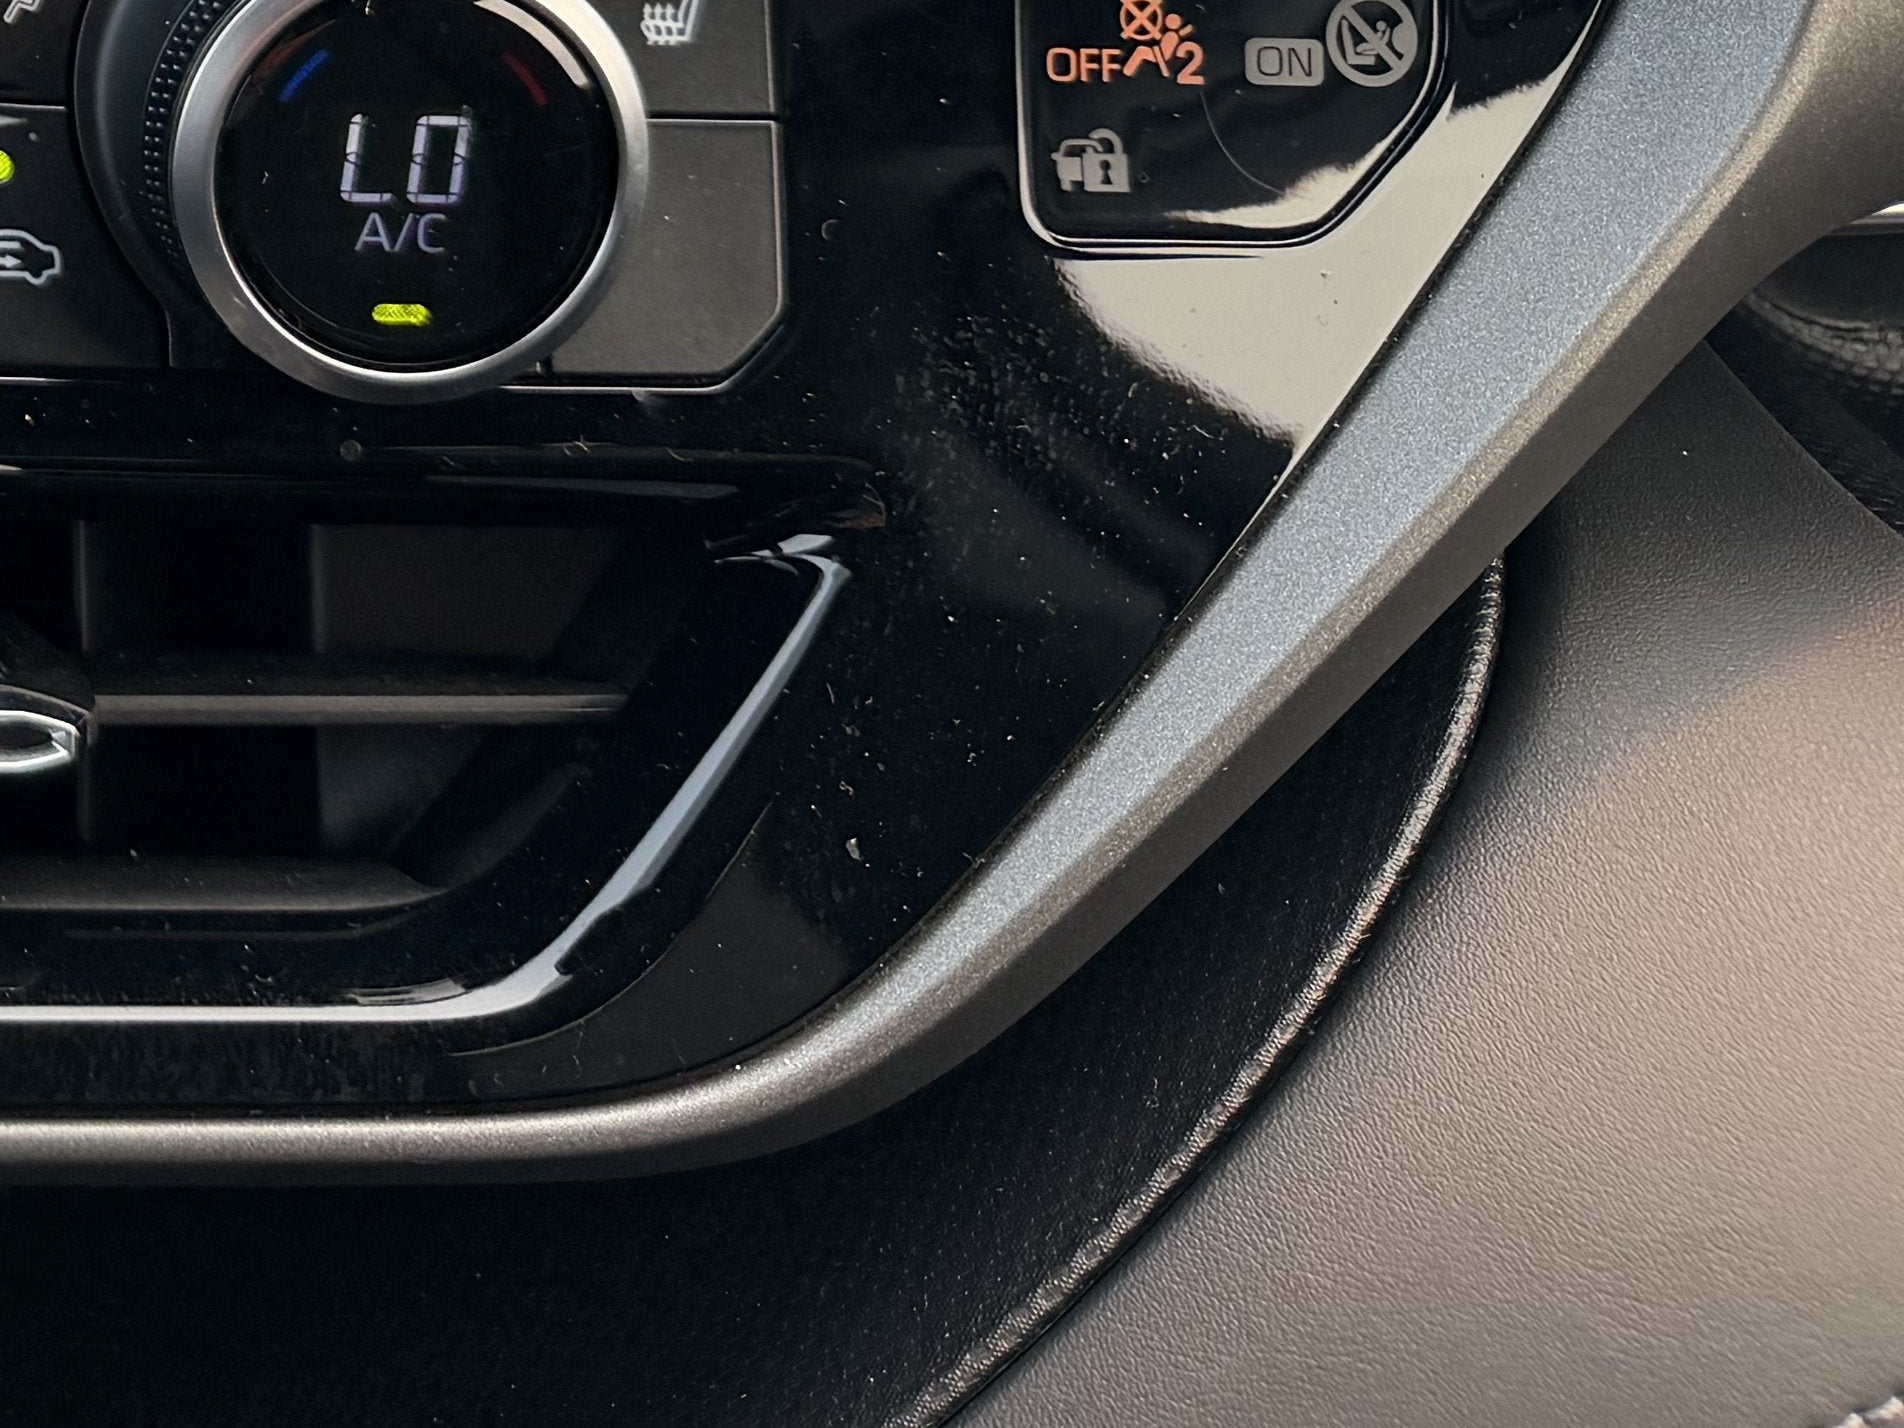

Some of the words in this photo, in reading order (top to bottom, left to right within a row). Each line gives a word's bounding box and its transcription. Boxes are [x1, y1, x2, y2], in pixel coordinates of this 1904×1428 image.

[1046, 46, 1123, 83] OFF
[1257, 46, 1313, 78] ON
[339, 112, 472, 204] LO
[354, 211, 448, 256] A/C
